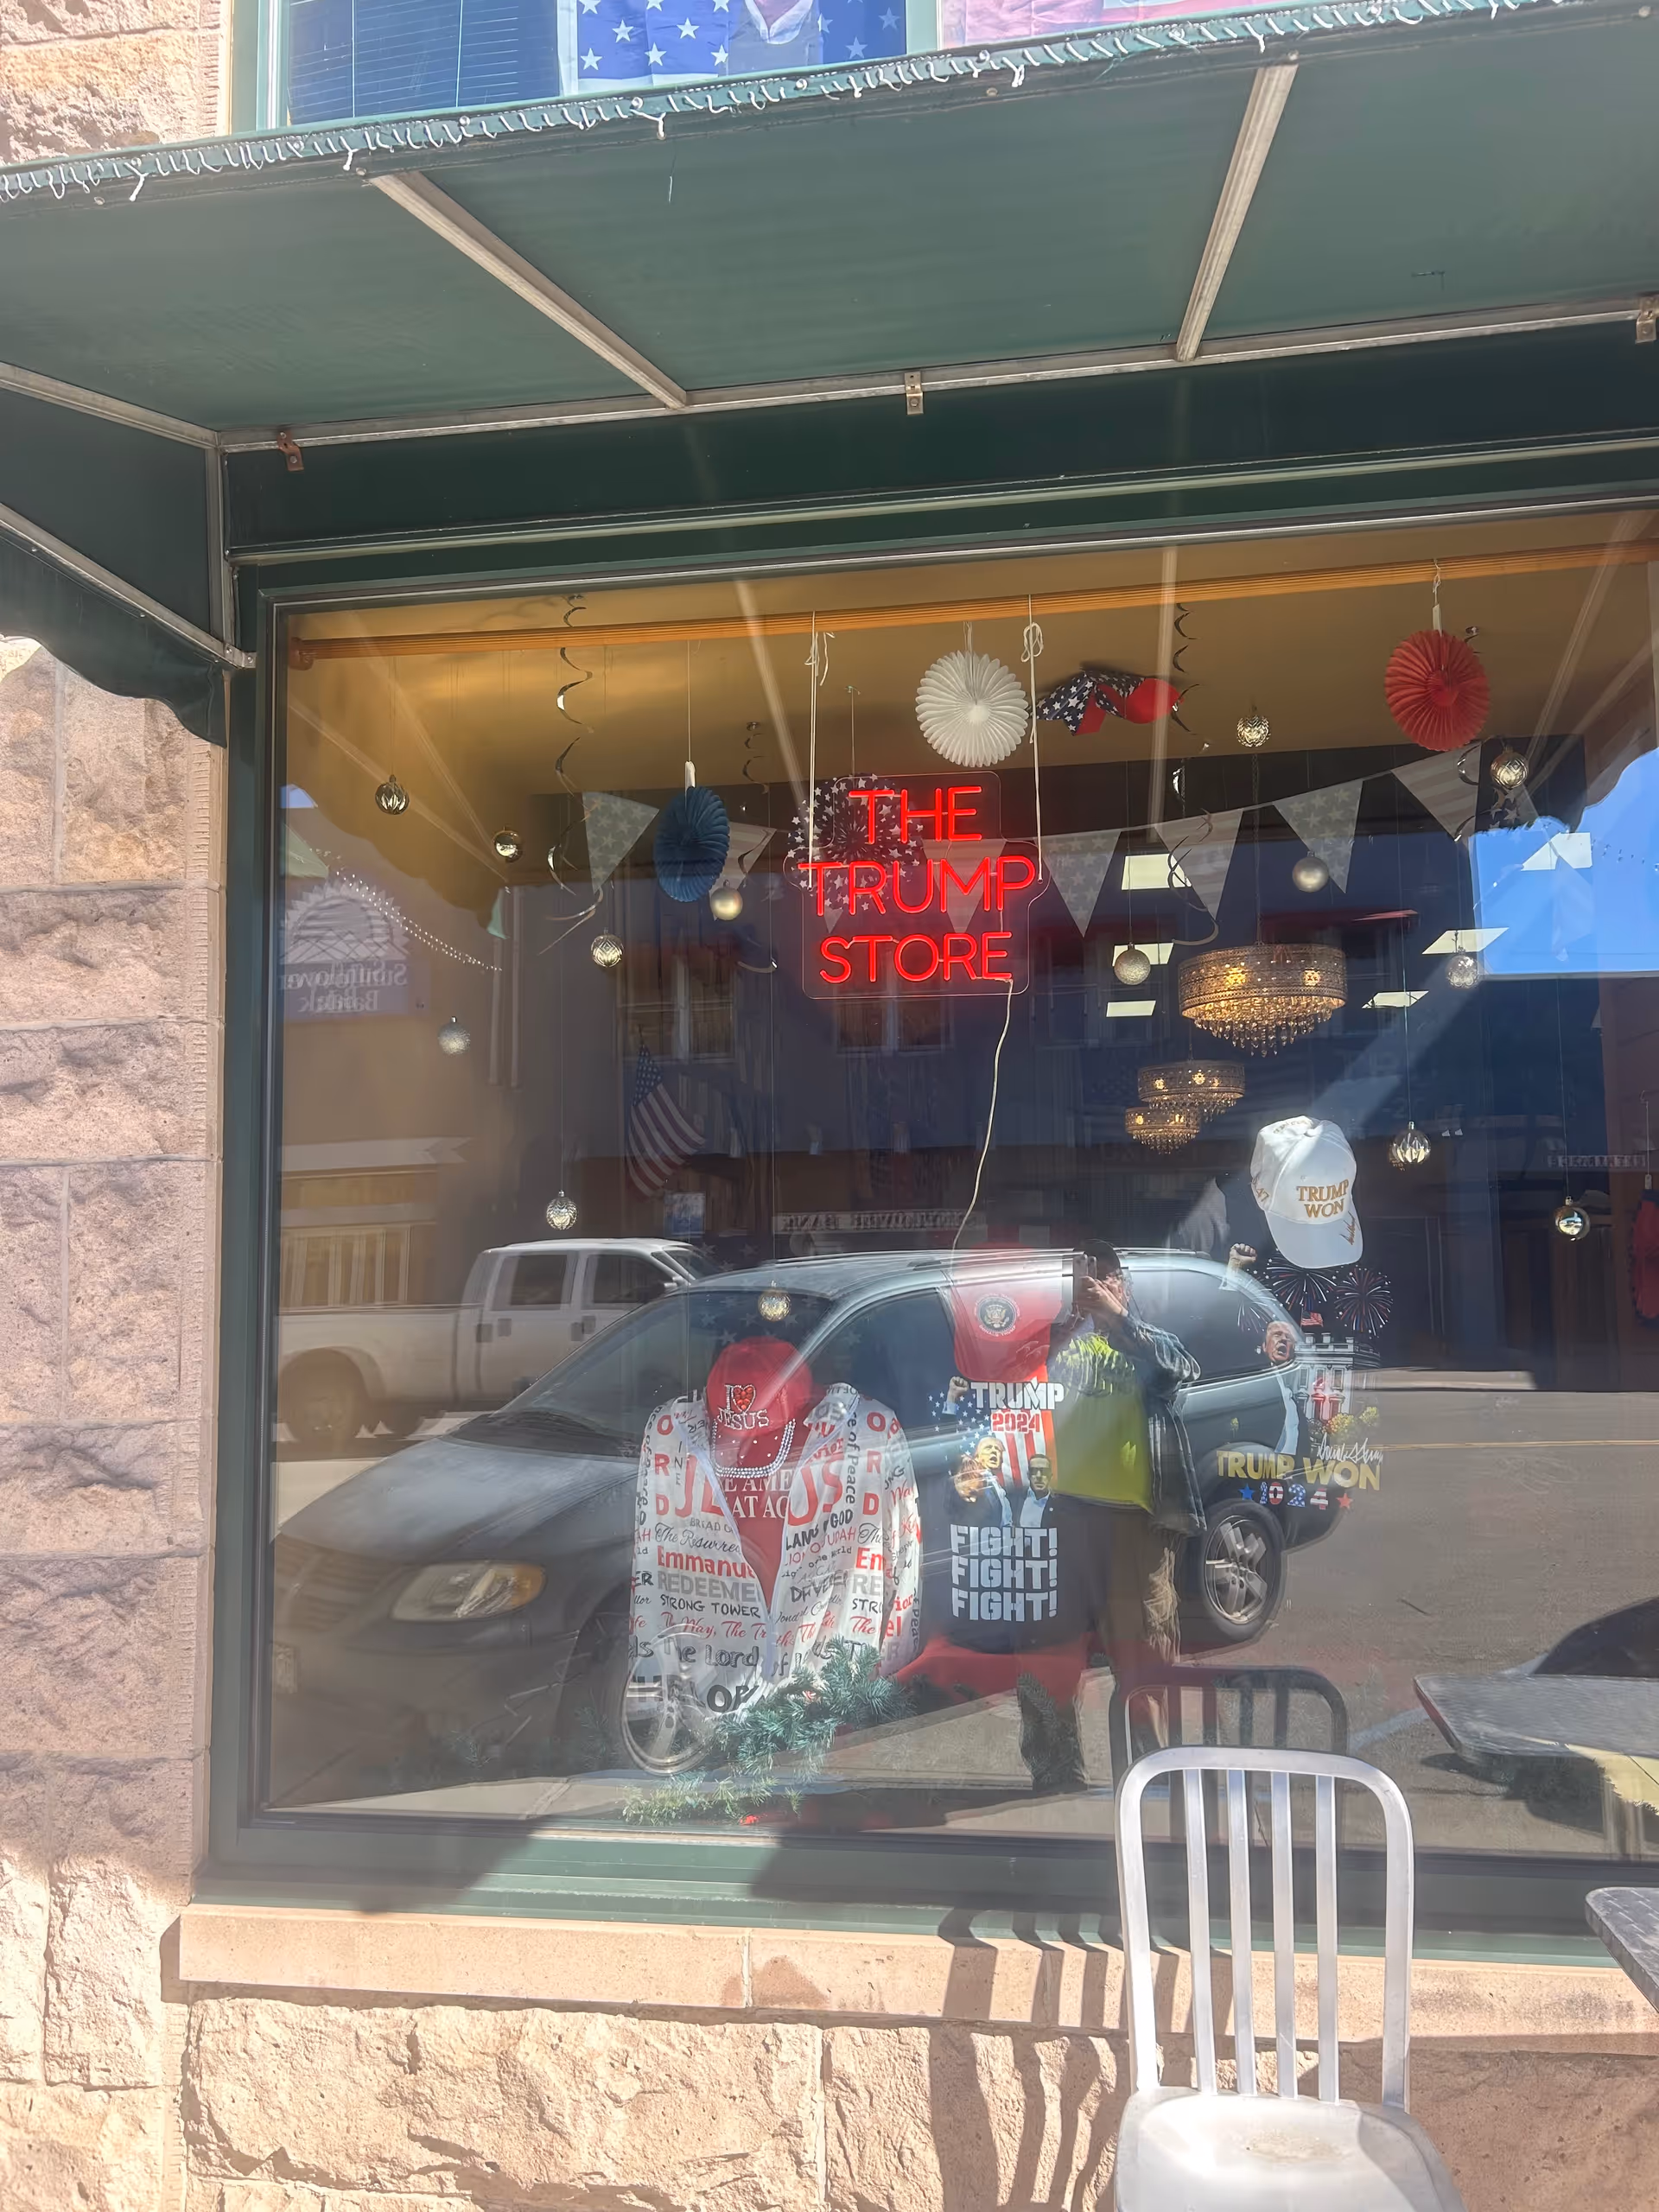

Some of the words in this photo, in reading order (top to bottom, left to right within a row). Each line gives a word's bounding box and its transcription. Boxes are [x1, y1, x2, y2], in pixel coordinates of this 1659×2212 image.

[848, 785, 982, 845] THE
[798, 855, 1036, 916] TRUMP
[819, 931, 1013, 983] STORE
[1296, 1179, 1350, 1203] TRUMP
[1304, 1198, 1345, 1218] WON
[970, 1382, 1065, 1411] TRUMP
[717, 1407, 770, 1431] JESUS
[991, 1411, 1041, 1433] 2024
[1216, 1450, 1296, 1480] TRUMP
[1302, 1457, 1381, 1491] WON
[741, 1469, 795, 1492] AME
[845, 1454, 859, 1505] Peace
[654, 1522, 678, 1543] The
[830, 1509, 854, 1529] GOD
[950, 1523, 1058, 1558] FIGHT!
[951, 1554, 1058, 1590] FIGHT!
[658, 1570, 761, 1604] REDEEME
[659, 1593, 706, 1612] STRONG
[711, 1601, 761, 1619] TOWER
[951, 1586, 1058, 1622] FIGHT!
[721, 1620, 747, 1637] The
[750, 1623, 766, 1641] Tr
[850, 1616, 876, 1636] The
[704, 1643, 761, 1669] Lord
